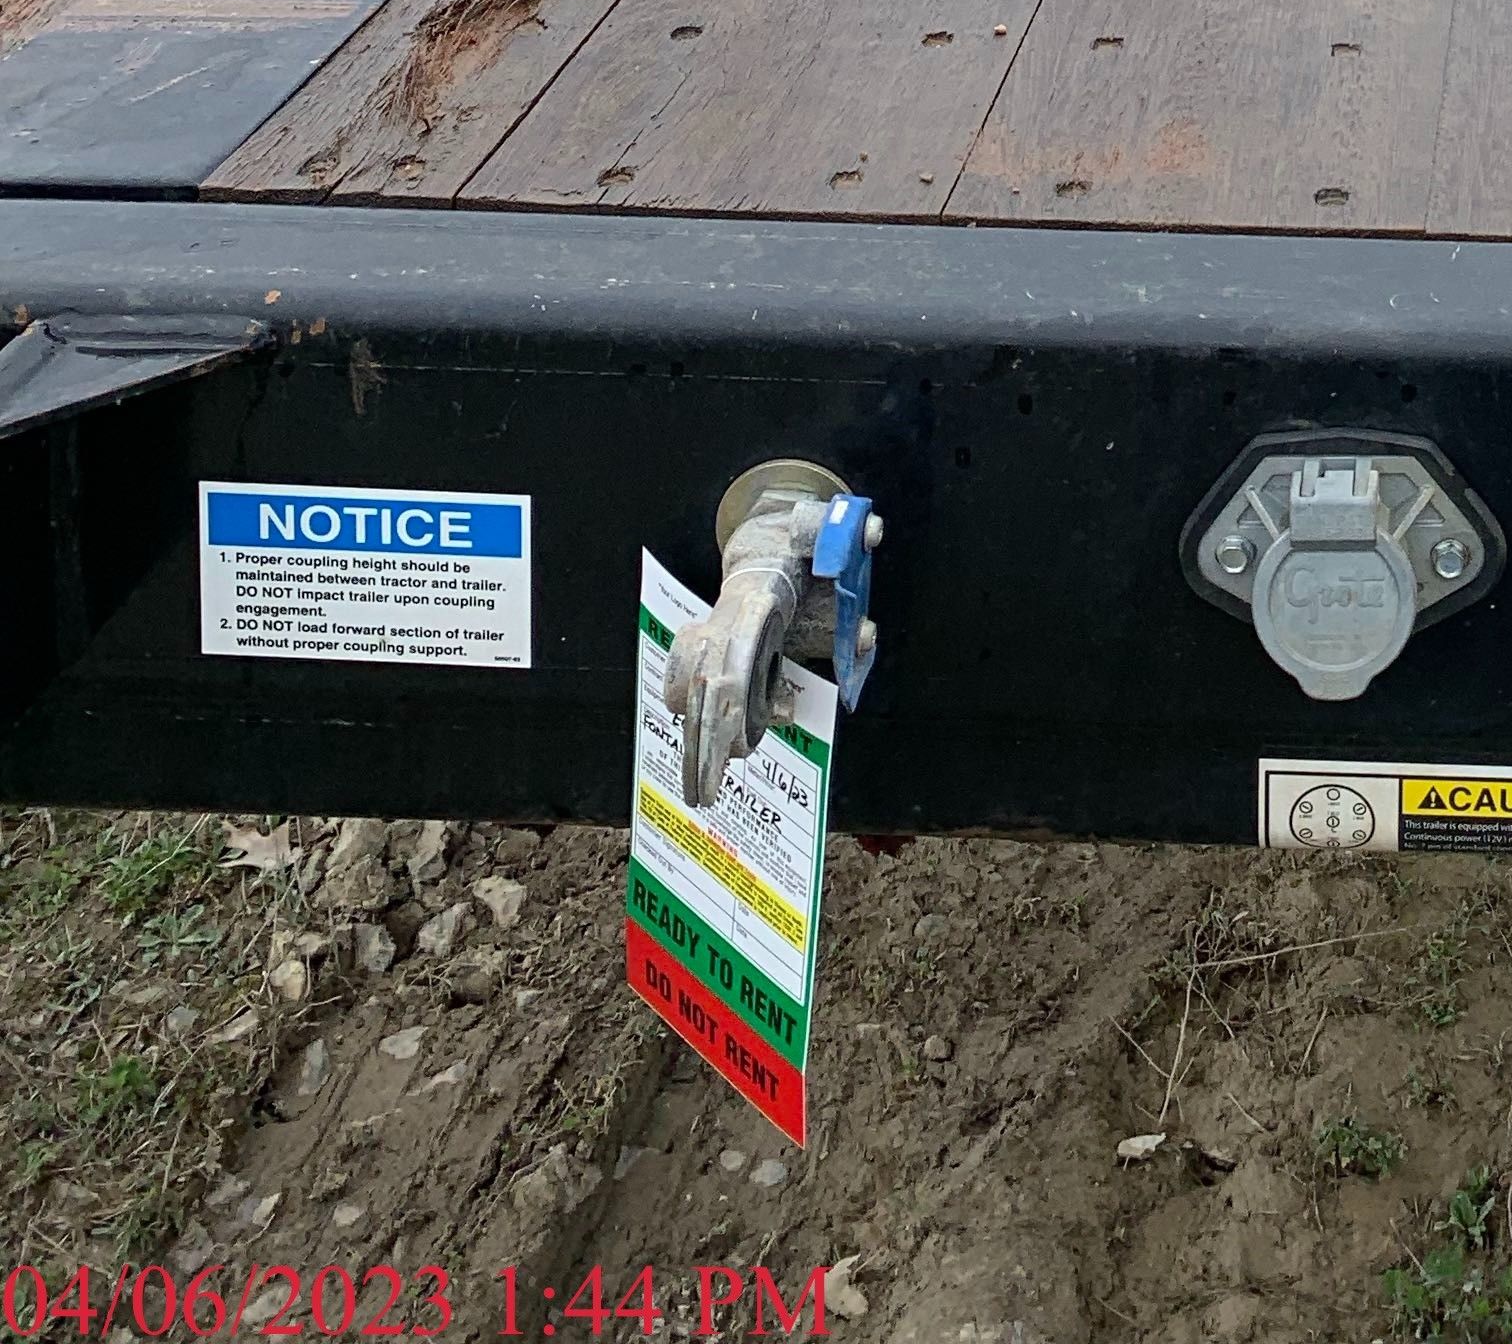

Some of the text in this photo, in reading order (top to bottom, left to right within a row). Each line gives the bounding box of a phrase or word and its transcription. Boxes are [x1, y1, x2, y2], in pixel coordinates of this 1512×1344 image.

[258, 502, 473, 548] NOTICE
[220, 551, 471, 573] 1. Proper coupling height should be
[236, 570, 507, 592] maintained between tractor and trailer.
[236, 585, 495, 610] DO NOT impact trailer upon coupling
[236, 604, 327, 618] engagement.
[220, 618, 504, 641] 2. DO NOT load forward section of trailer
[237, 635, 467, 658] without proper coupling support.
[763, 758, 809, 808] 4/6/23
[1404, 820, 1420, 830] This
[1423, 820, 1448, 831] trailer
[1449, 821, 1457, 831] is
[1457, 821, 1499, 834] equipped
[1404, 832, 1452, 842] Continuous
[1454, 835, 1482, 845] power
[632, 877, 700, 960] READY
[706, 943, 733, 992] TO
[739, 968, 798, 1047] RENT
[645, 957, 780, 1102] DO NOT RENT
